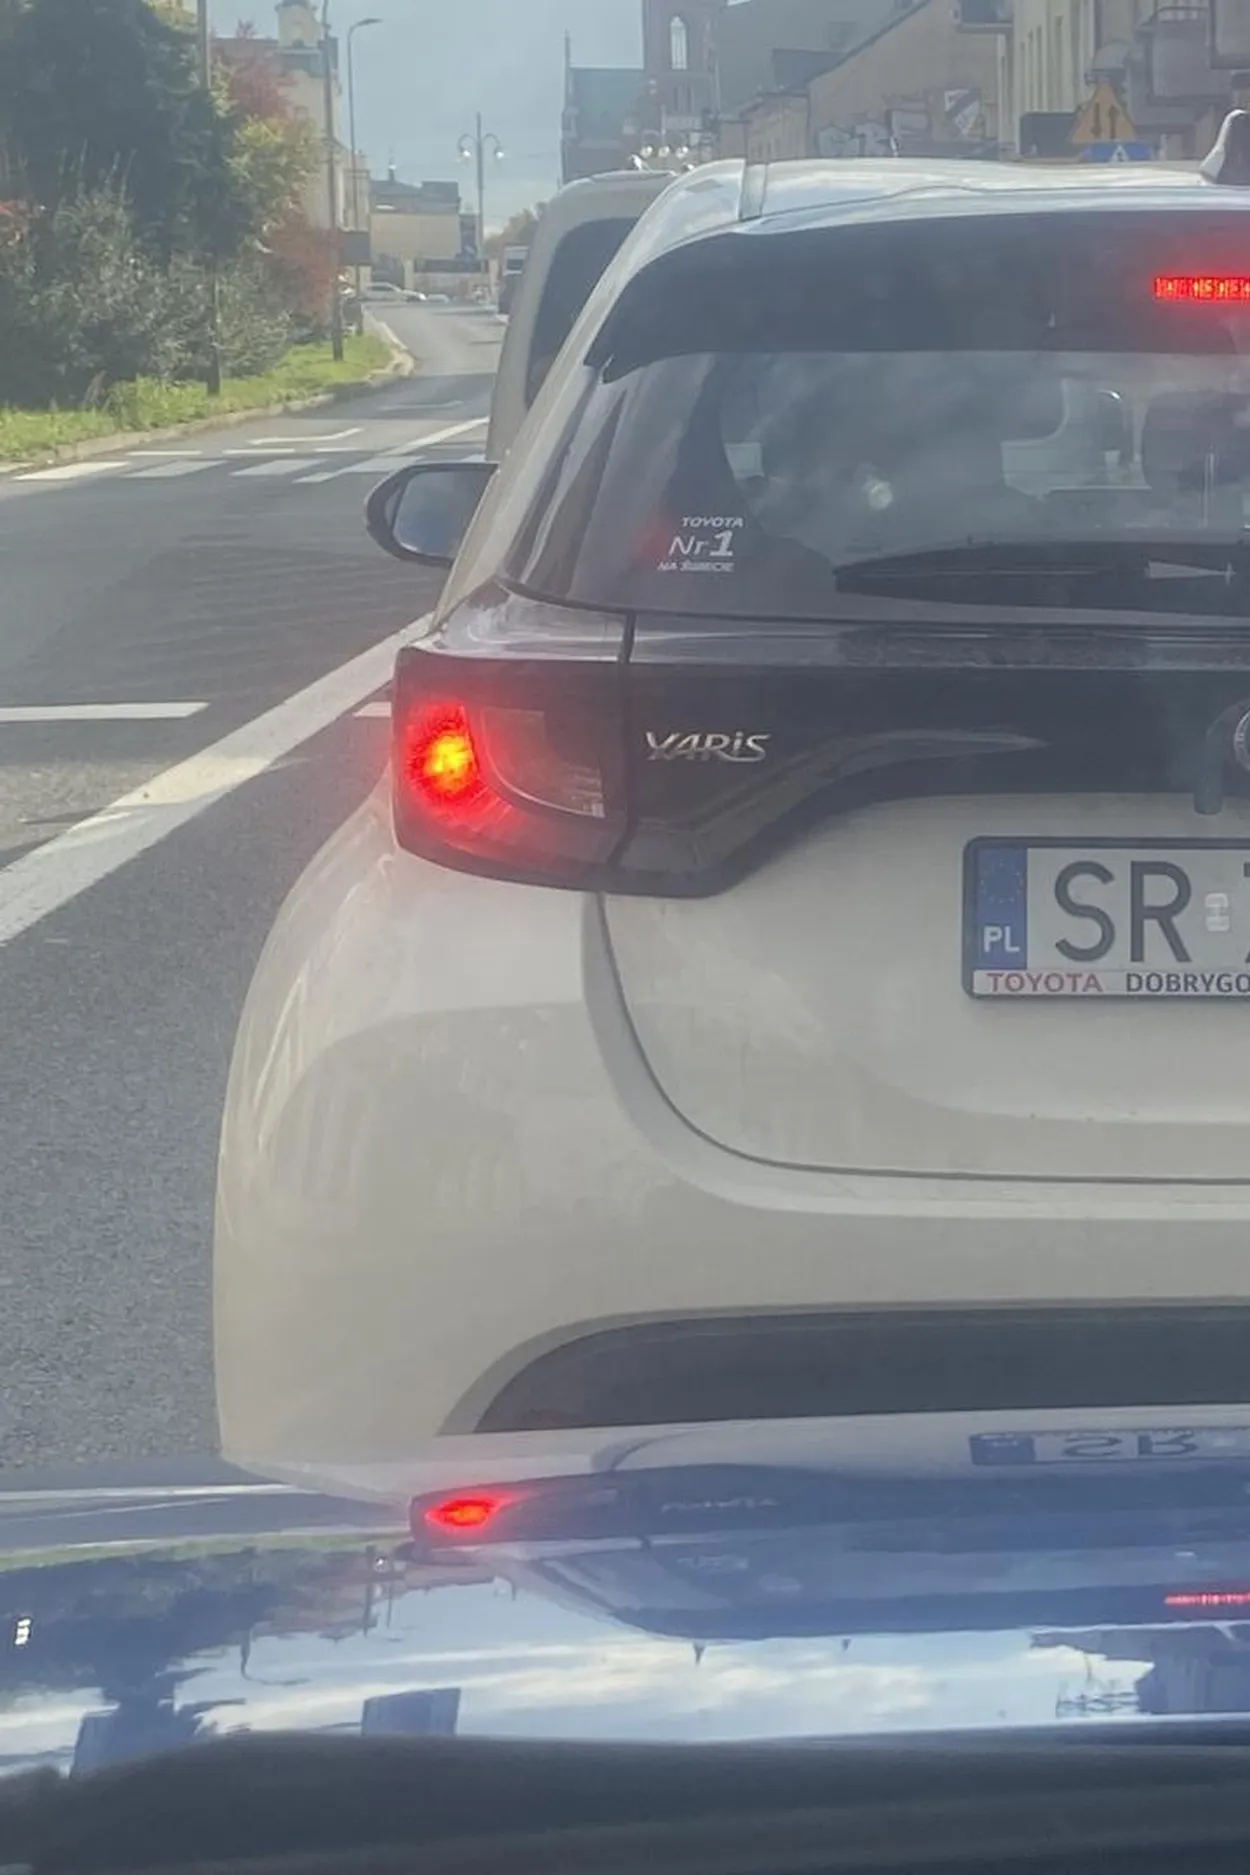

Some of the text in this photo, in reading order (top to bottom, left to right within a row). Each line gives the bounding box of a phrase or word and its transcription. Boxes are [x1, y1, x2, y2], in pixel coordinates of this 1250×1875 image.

[681, 516, 743, 528] TOYOTA
[1054, 860, 1192, 963] SR
[983, 925, 1020, 953] PL
[987, 972, 1103, 993] TOYOTA
